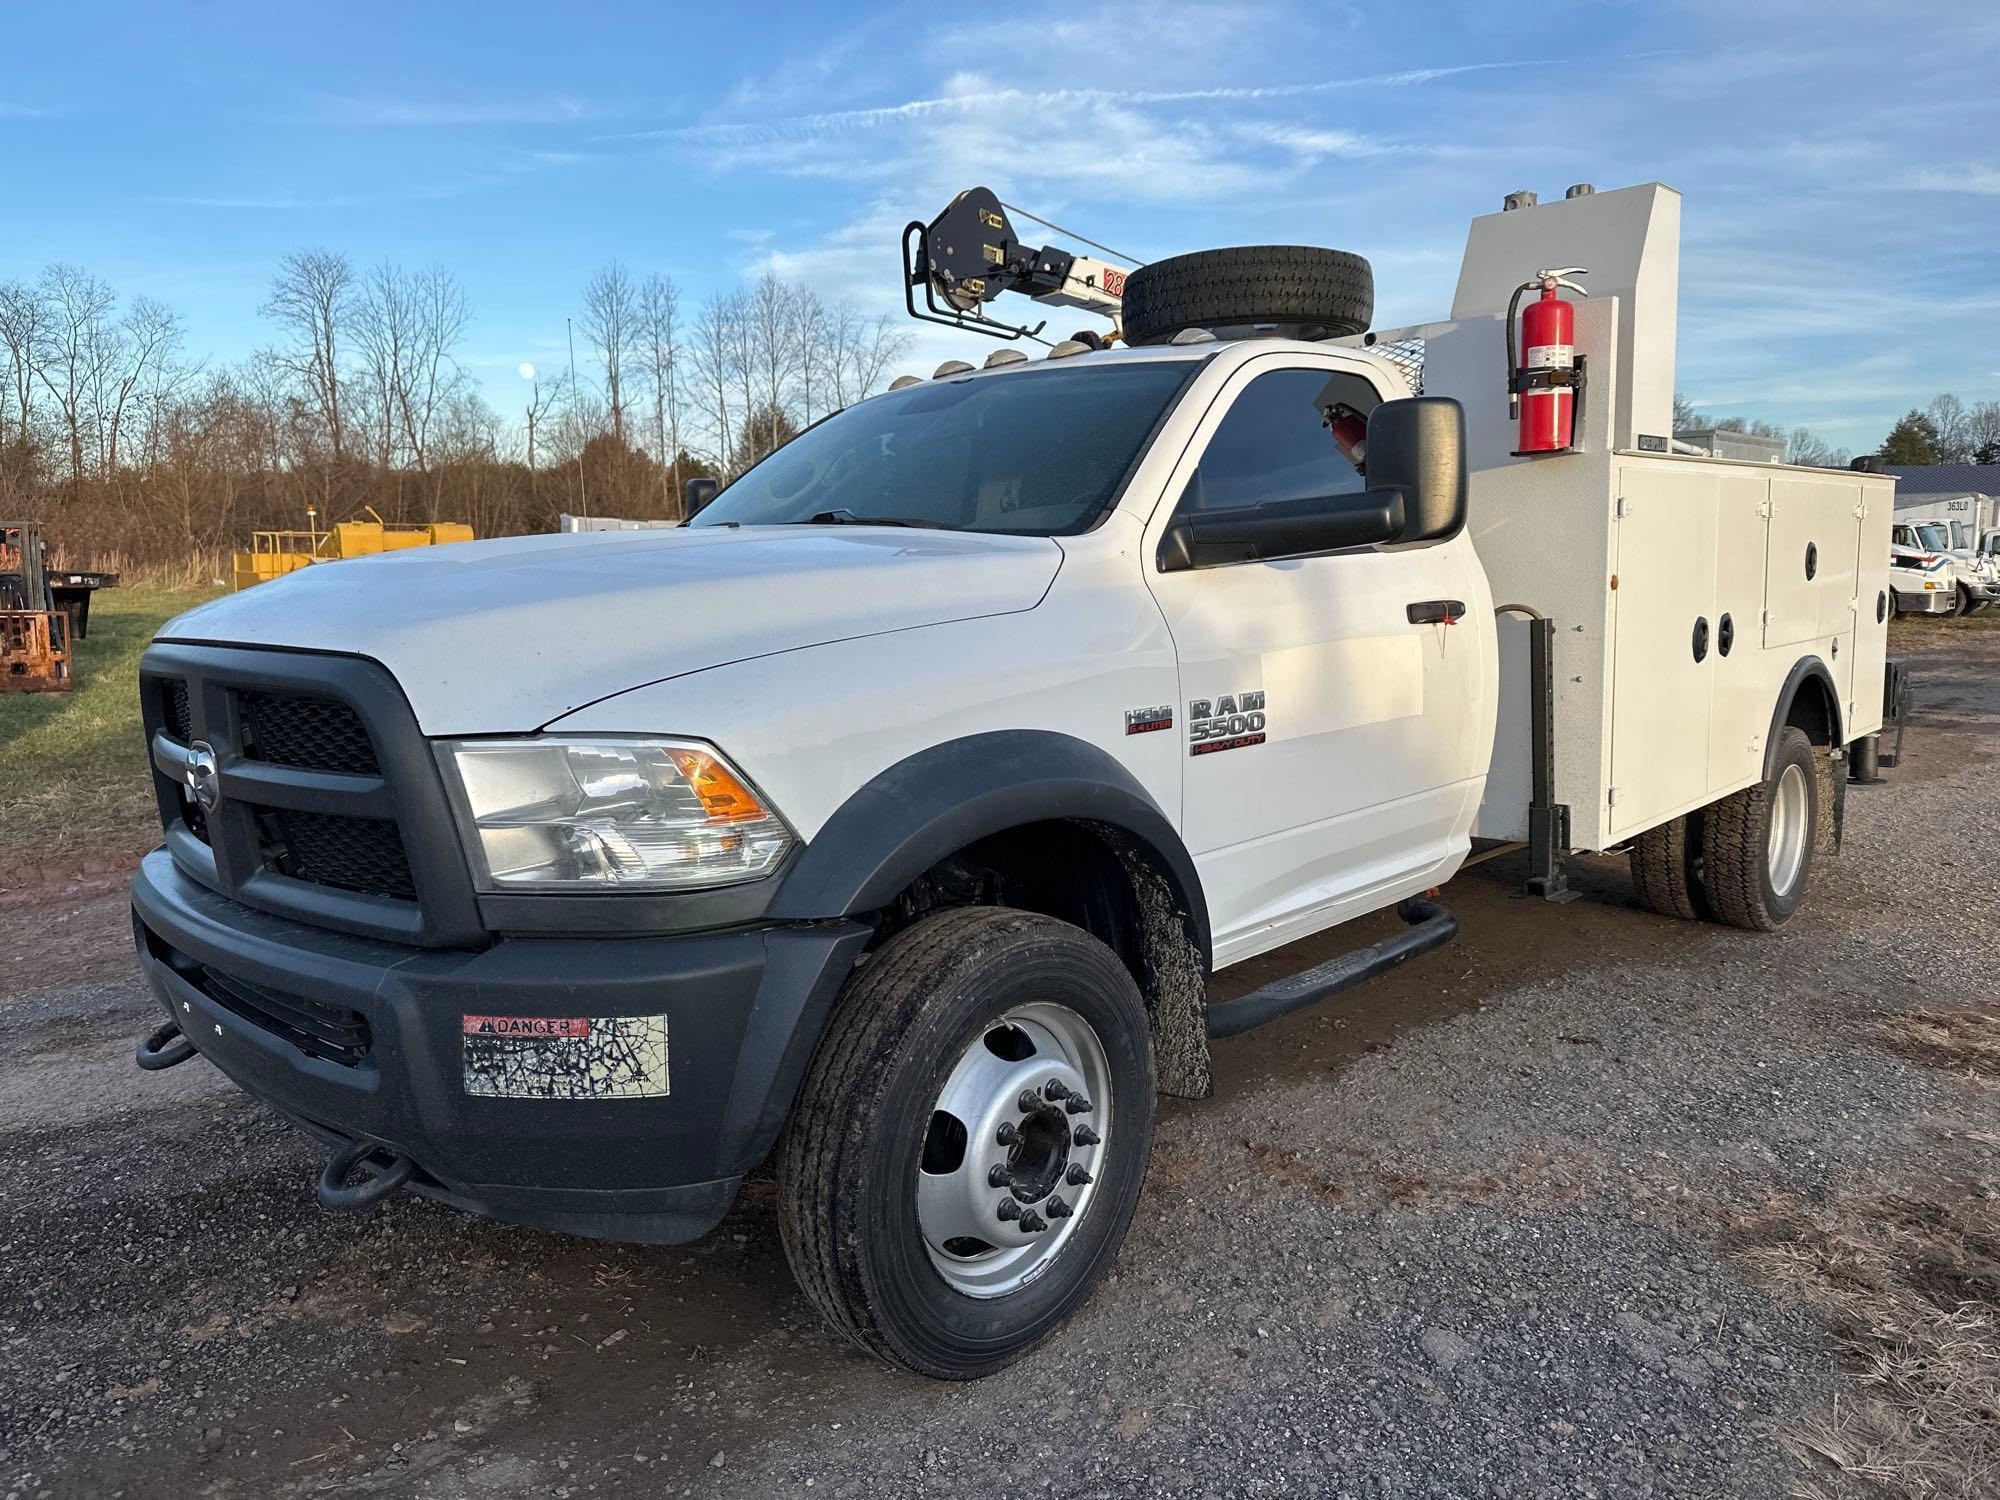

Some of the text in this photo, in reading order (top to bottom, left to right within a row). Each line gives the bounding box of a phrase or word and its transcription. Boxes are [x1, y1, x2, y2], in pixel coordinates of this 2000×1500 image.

[1125, 705, 1172, 724] HEMI
[1189, 691, 1265, 720] RAM
[1190, 711, 1266, 742] 5500
[1194, 734, 1265, 754] HEAVY DUTY
[498, 1020, 570, 1034] DANGER
